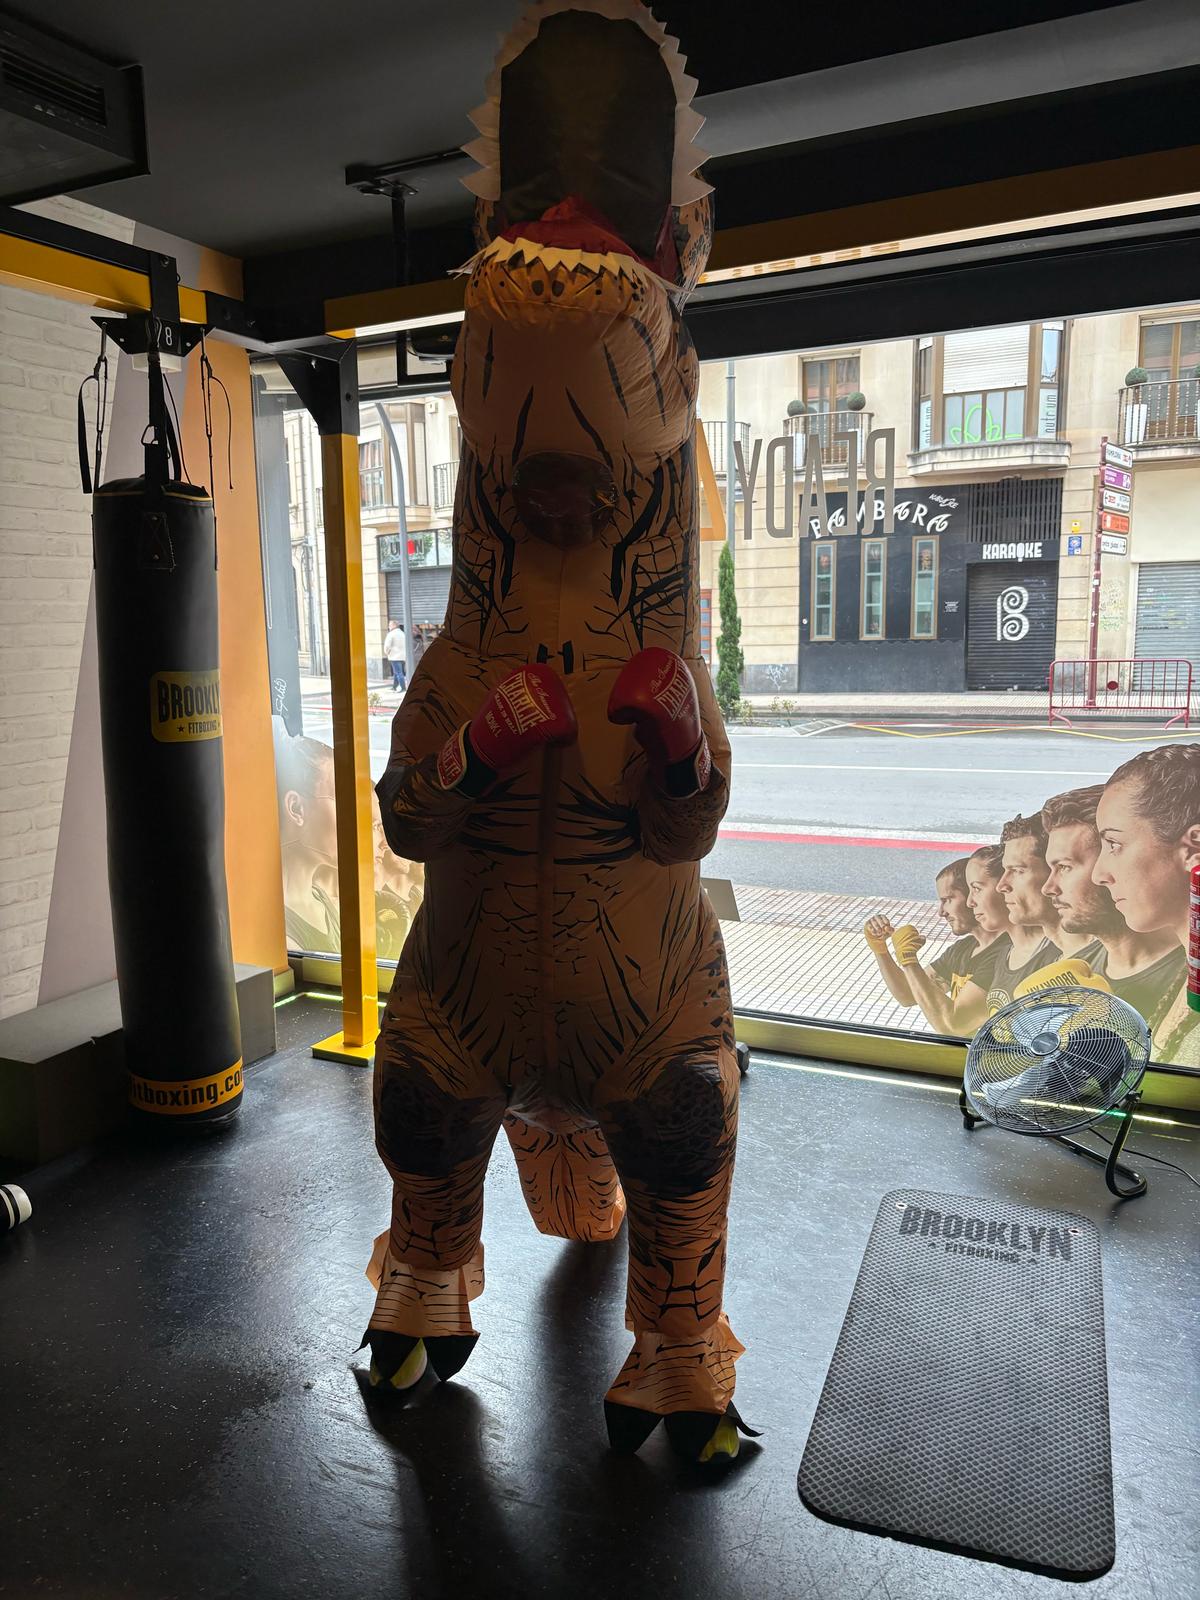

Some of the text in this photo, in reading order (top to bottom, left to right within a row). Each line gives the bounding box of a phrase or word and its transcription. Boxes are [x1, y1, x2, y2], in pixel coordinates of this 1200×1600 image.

[982, 542, 1043, 562] KARAOKE
[500, 672, 546, 732] CHARLIE
[188, 719, 217, 735] FITBOXING
[129, 1067, 243, 1106] itboxing.co
[899, 1205, 1073, 1262] BROOKLYN
[944, 1242, 1020, 1264] FITBOXING
